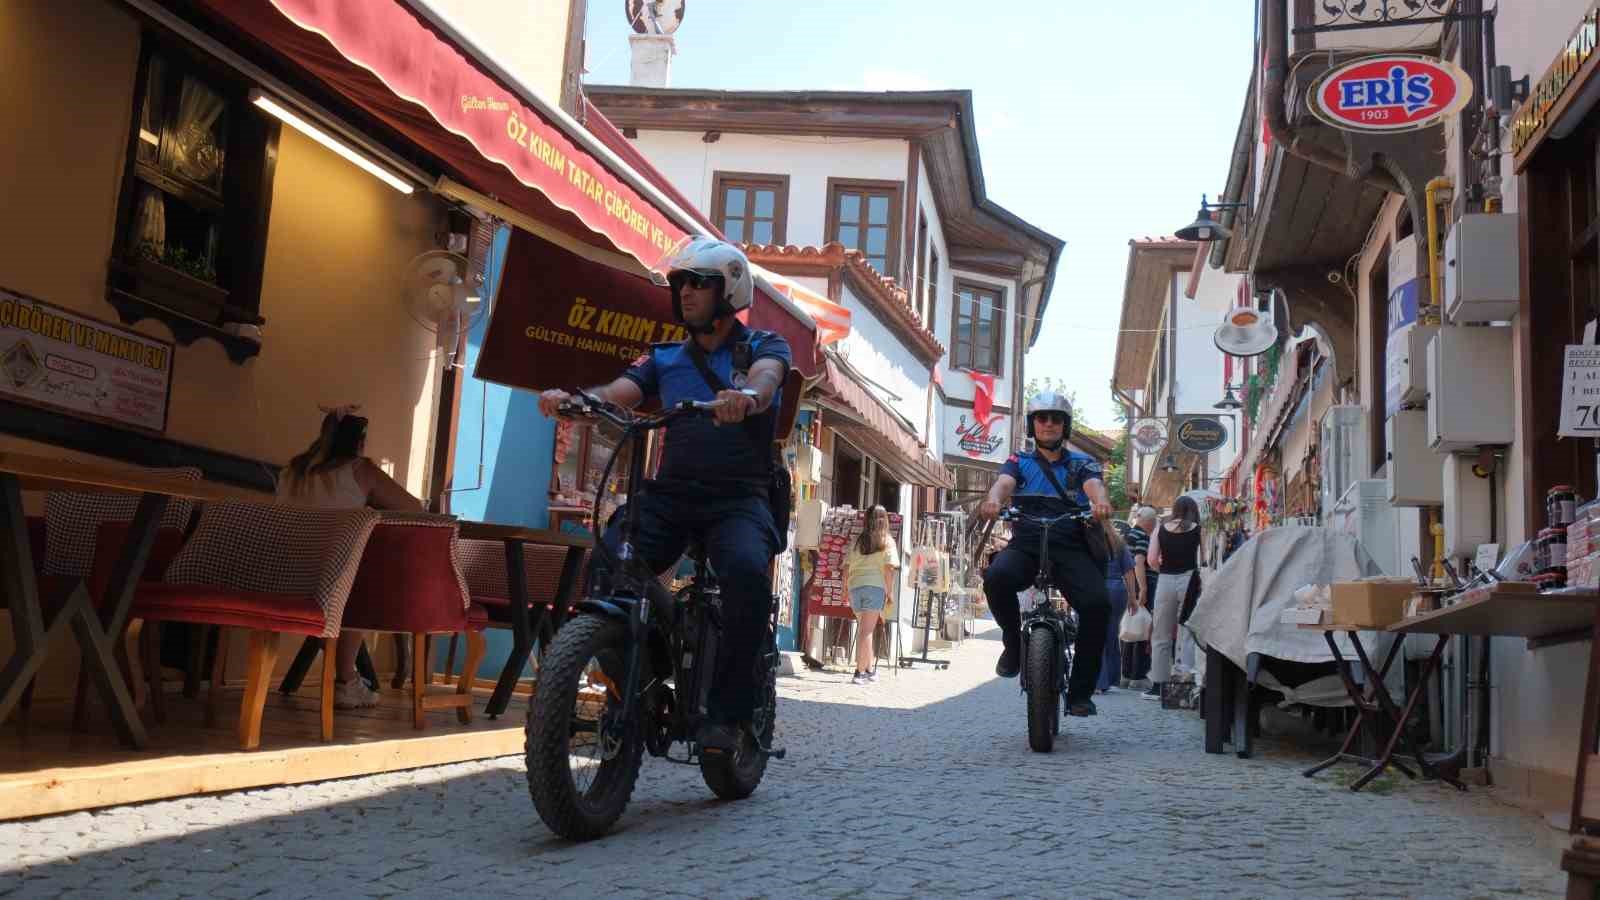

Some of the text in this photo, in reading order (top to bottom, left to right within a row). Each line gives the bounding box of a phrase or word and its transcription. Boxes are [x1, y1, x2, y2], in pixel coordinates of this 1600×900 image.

[1360, 109, 1390, 121] 1903
[506, 112, 528, 149] ÖZ
[529, 134, 564, 177] KIRIM
[567, 159, 603, 206] TATAR
[604, 189, 650, 240] ÇİBÖREK
[651, 223, 664, 249] VE
[0, 299, 169, 370] ÇİBÖREK VE MANTI EVİ
[525, 322, 648, 361] GÜLTEN HANIM ÇİB
[567, 294, 689, 344] ÖZ KIRIM TA
